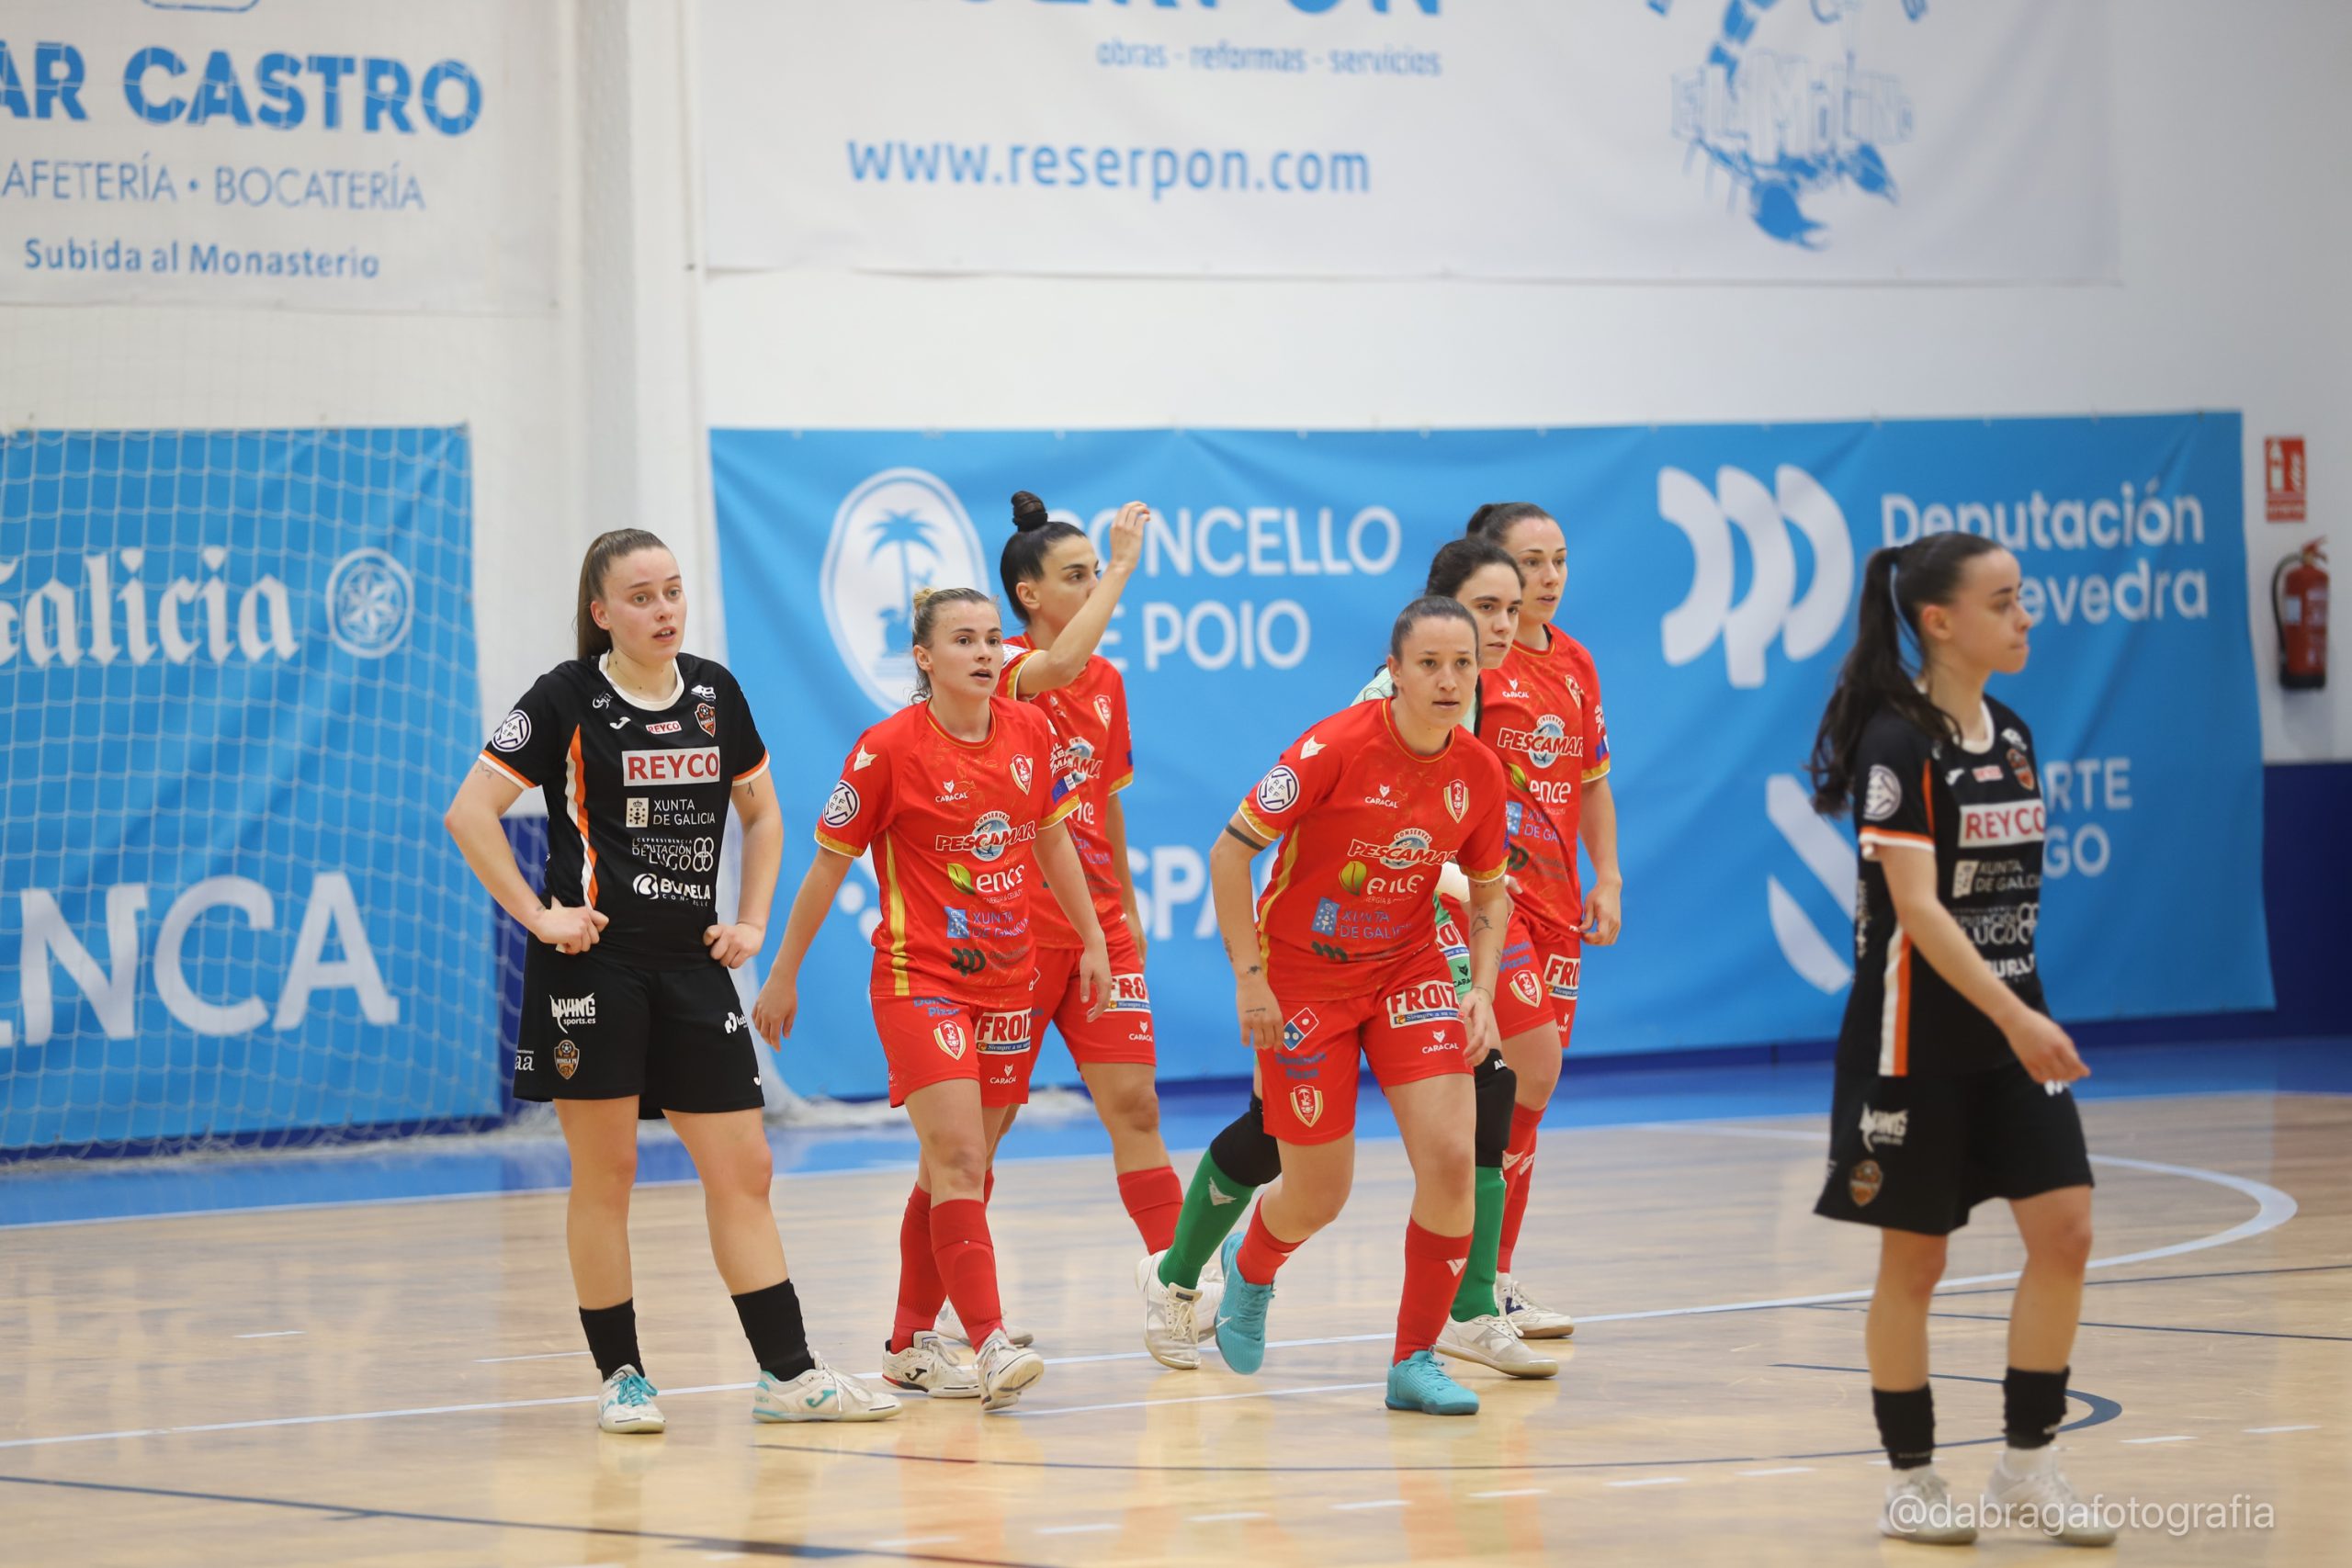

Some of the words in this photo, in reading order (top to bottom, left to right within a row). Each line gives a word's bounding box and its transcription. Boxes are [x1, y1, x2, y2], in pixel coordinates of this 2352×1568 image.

[1096, 39, 1168, 69] obras
[1190, 42, 1306, 73] reformas
[1329, 47, 1442, 77] servicios
[123, 46, 483, 136] CASTRO
[847, 140, 1372, 202] www.reserpon.com
[214, 163, 426, 211] BOCATERÍA
[25, 238, 141, 271] Subida
[152, 242, 178, 272] al
[189, 244, 379, 278] Monasterio
[1143, 599, 1311, 672] POIO
[648, 722, 680, 733] REYCO
[628, 754, 719, 780] REYCO
[653, 798, 695, 811] XUNTA
[935, 792, 968, 803] CARACAL
[1364, 796, 1398, 809] CARACAL
[653, 812, 671, 826] DE
[673, 811, 716, 825] GALICIA
[975, 812, 1010, 827] CONSERVAS
[1965, 806, 2044, 840] REYCO
[935, 820, 1035, 852] PESCAMAR
[1395, 829, 1431, 844] CONSERVAS
[1340, 926, 1360, 939] DE
[563, 1017, 596, 1027] sports.es
[1422, 1043, 1459, 1055] CARACAL
